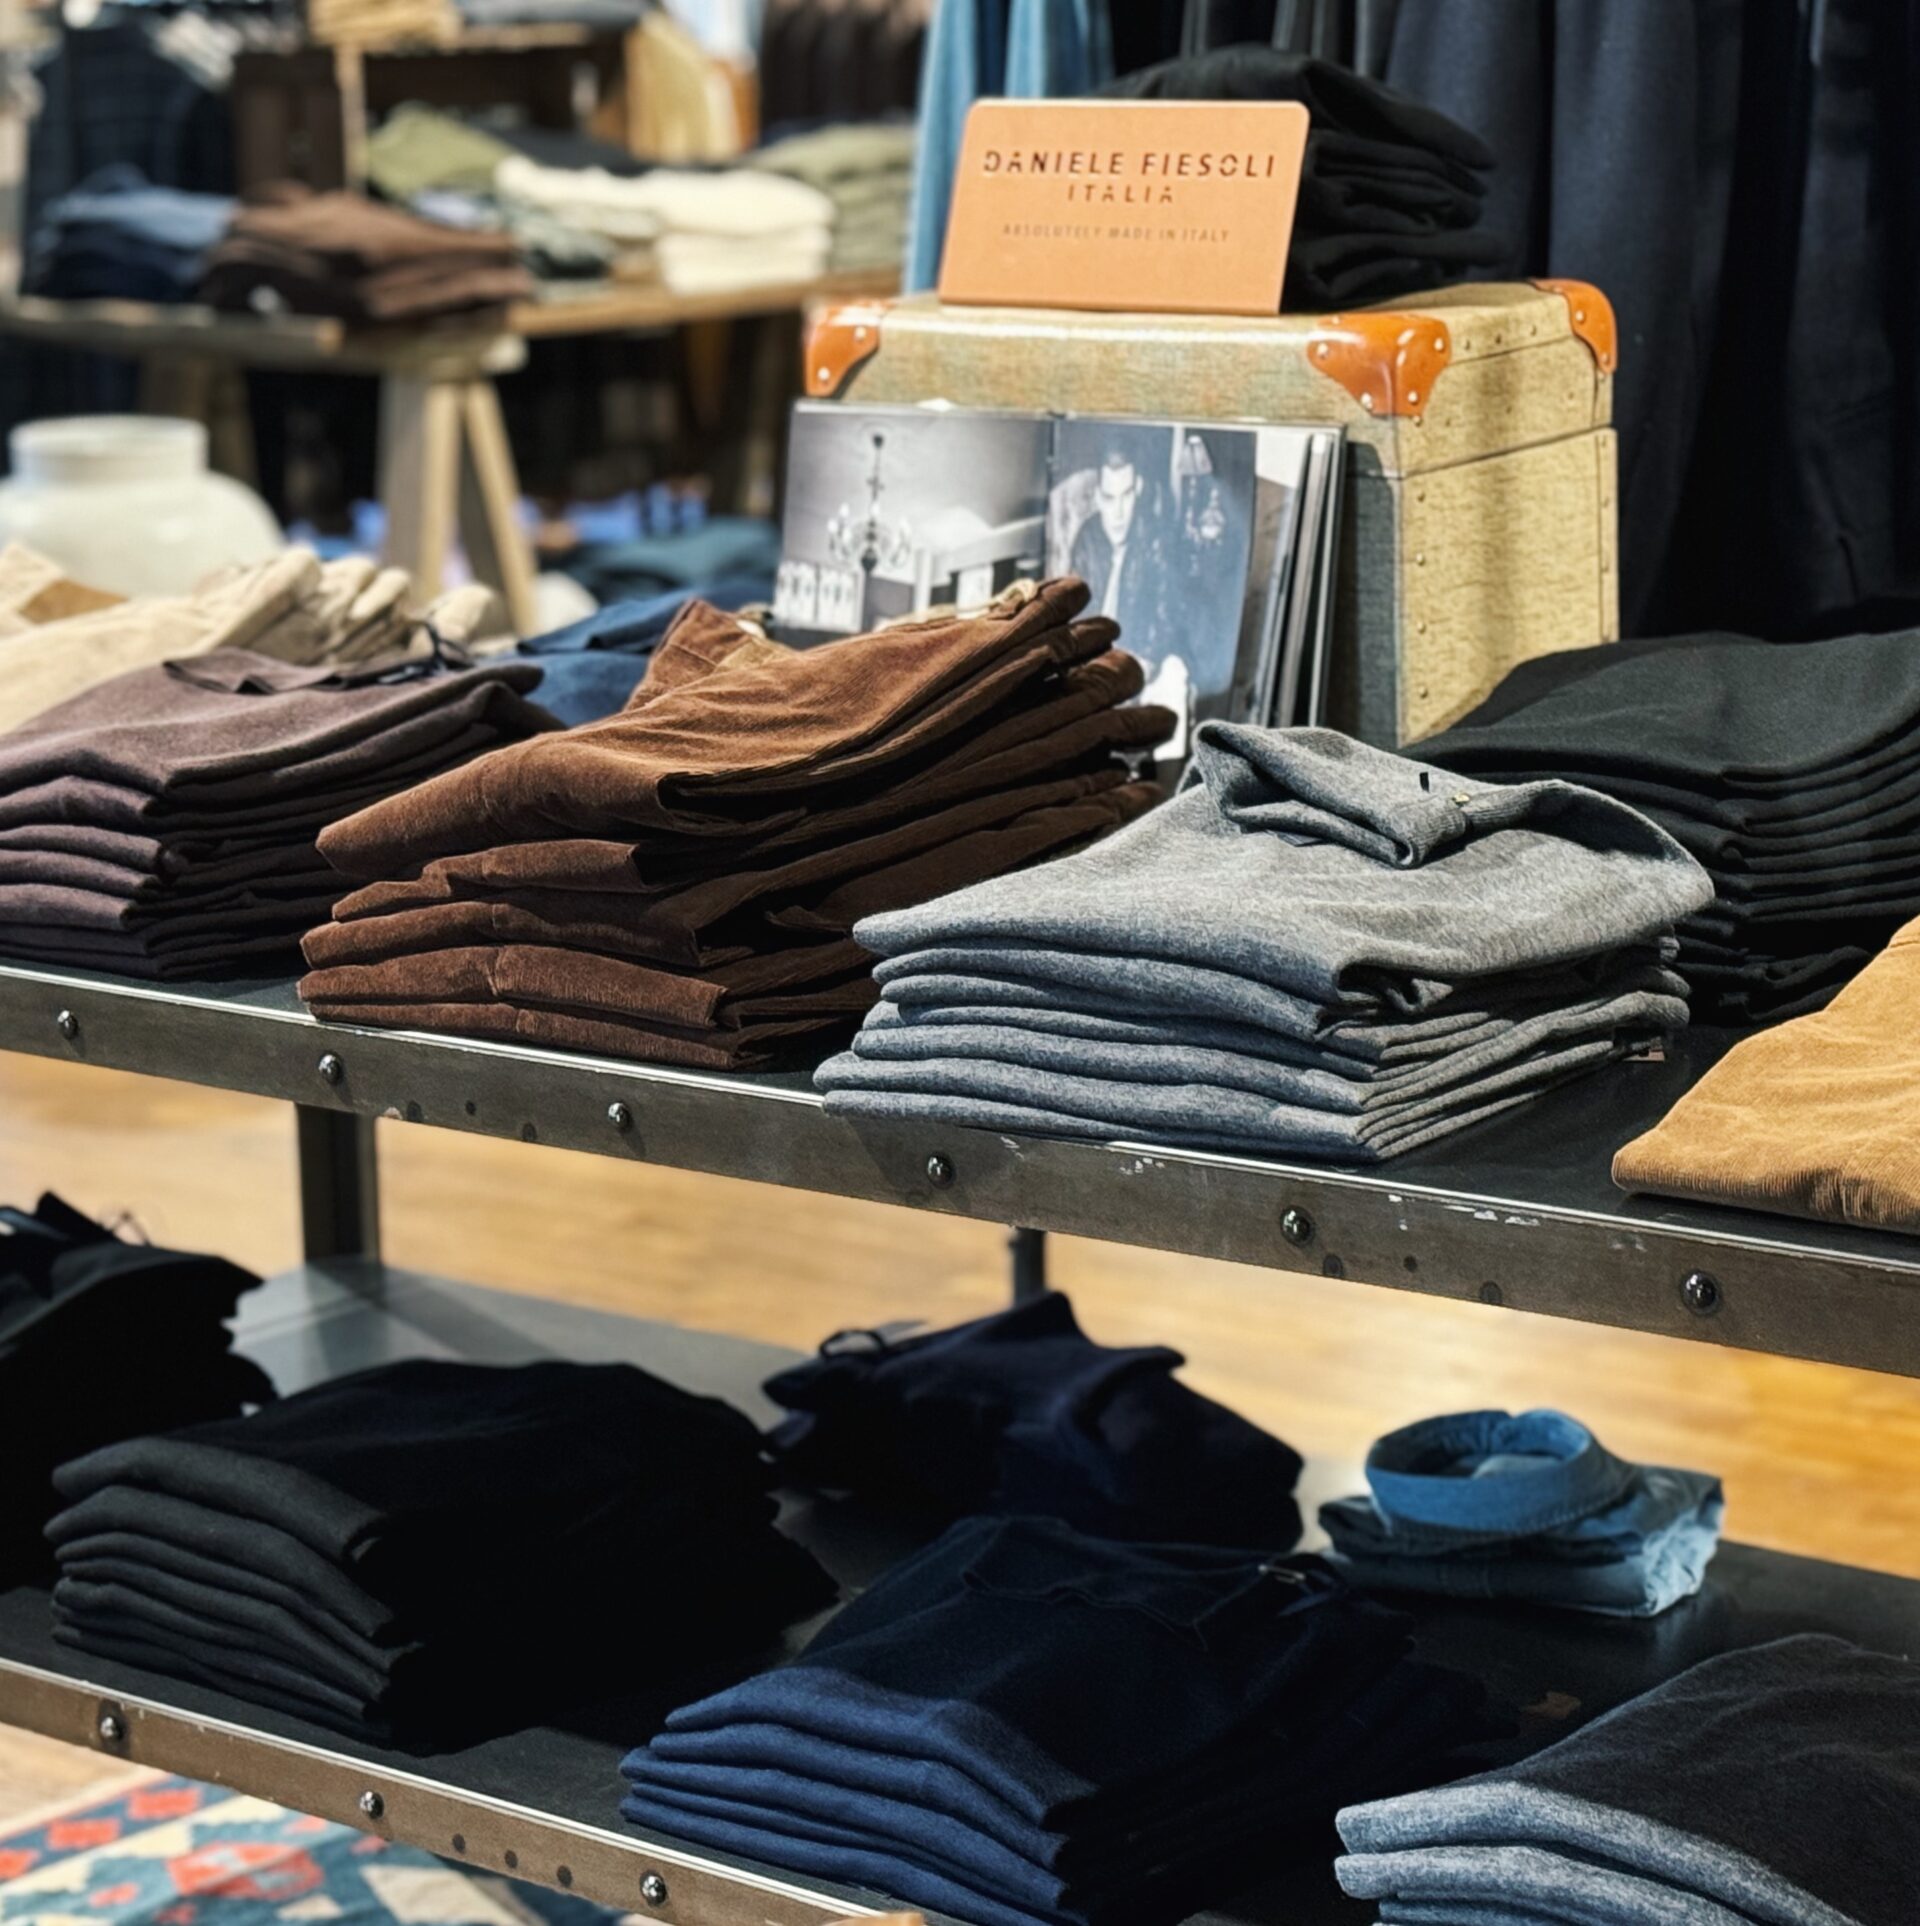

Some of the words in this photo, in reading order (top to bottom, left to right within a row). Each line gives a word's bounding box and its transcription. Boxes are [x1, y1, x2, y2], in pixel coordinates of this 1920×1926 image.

[984, 150, 1125, 174] DANIELE
[1141, 153, 1275, 178] FIESOLI
[1067, 184, 1173, 203] ITALIA
[1003, 223, 1101, 239] ABSOLUTELY
[1109, 226, 1151, 240] MADE
[1158, 228, 1176, 240] IN
[1182, 229, 1229, 242] ITALY
